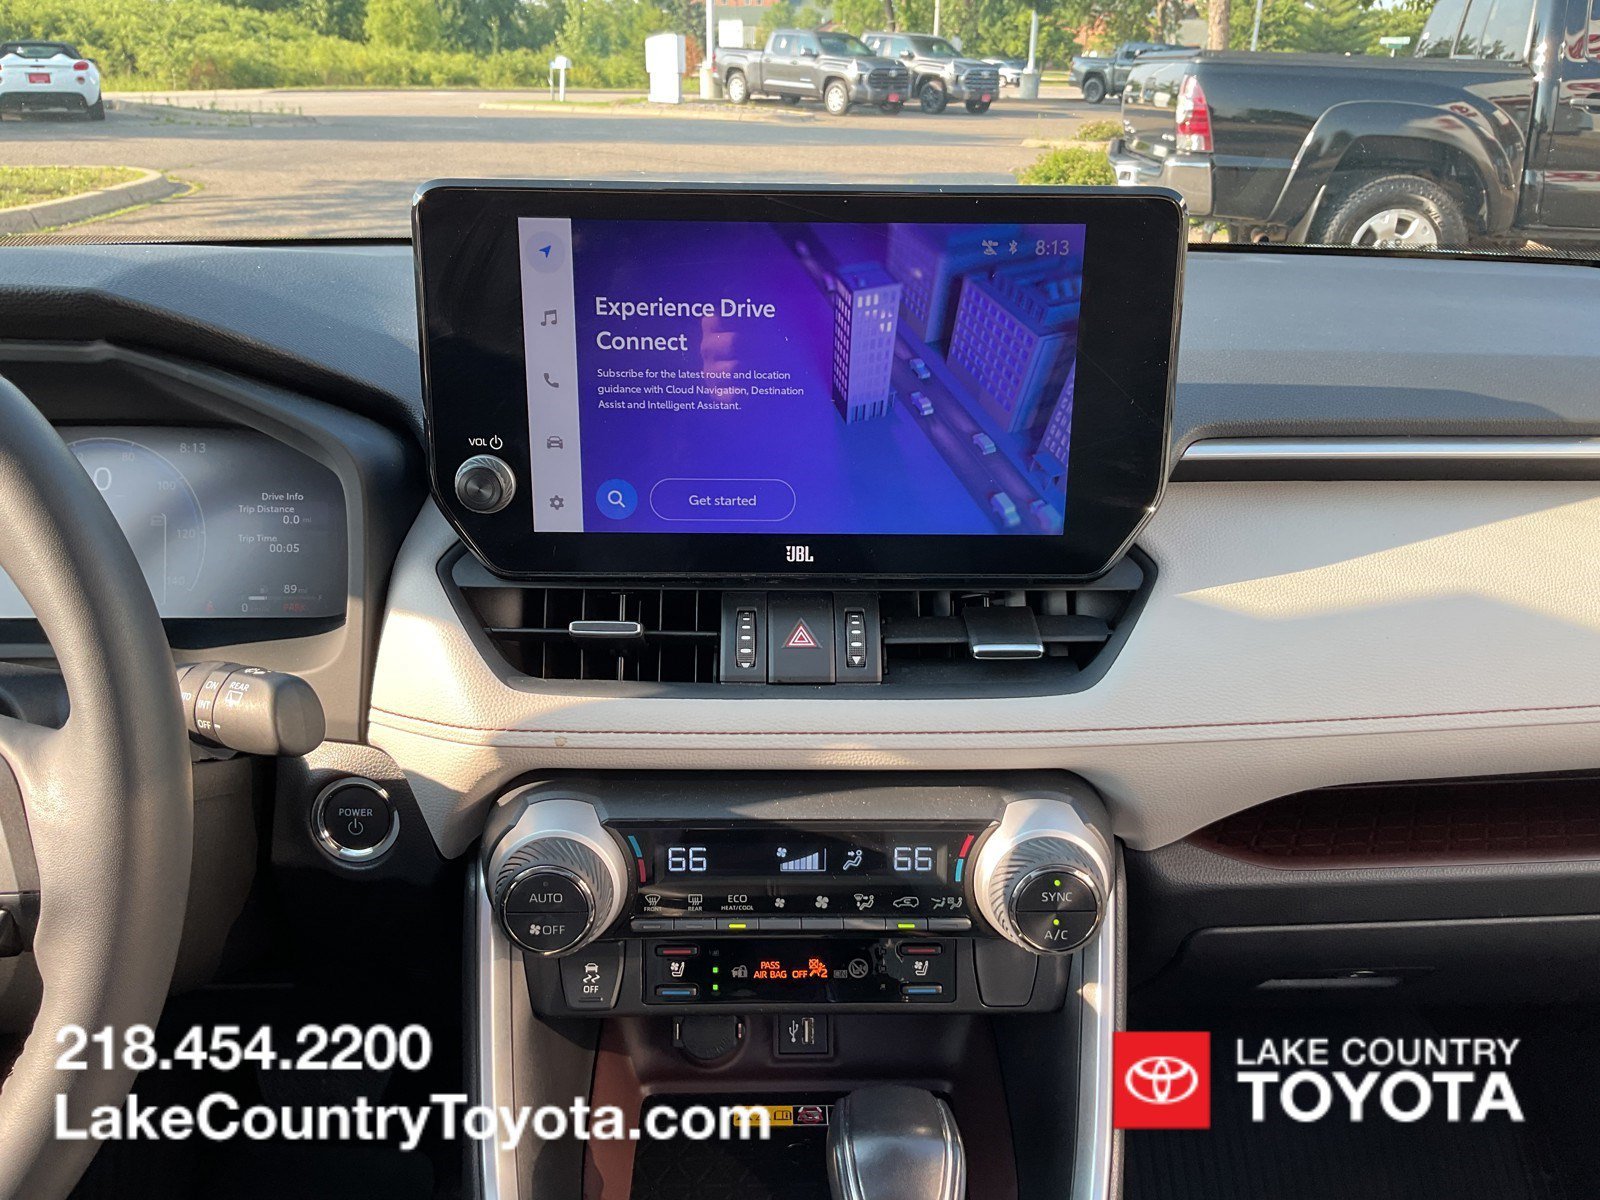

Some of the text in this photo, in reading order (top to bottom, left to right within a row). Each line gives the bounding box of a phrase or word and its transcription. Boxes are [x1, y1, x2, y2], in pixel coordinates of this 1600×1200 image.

[1035, 239, 1070, 256] 8:13
[595, 296, 776, 321] Experience Drive
[596, 331, 688, 351] Connect
[597, 368, 791, 380] Subscribe for the latest route and location
[597, 384, 804, 397] guidance with Cloud Navigation, Destination
[597, 399, 742, 412] Assist and Intelligent Assistant.
[468, 437, 488, 447] VOL
[179, 442, 207, 454] 8:13
[93, 466, 113, 491] 0
[261, 492, 304, 501] Drive Info
[688, 494, 757, 506] Get started
[238, 504, 295, 514] Trip Distance
[282, 515, 300, 525] 0.0
[238, 534, 278, 544] Trip Time
[269, 543, 300, 553] 00:05
[785, 545, 814, 562] JBL
[283, 584, 298, 594] 89
[205, 680, 219, 690] ON
[229, 681, 250, 692] REAR
[197, 719, 212, 729] OFF
[338, 808, 373, 817] POWER
[667, 846, 932, 872] 66 66
[529, 893, 563, 903] AUTO
[727, 894, 748, 903] ECO
[1041, 891, 1073, 902] SYNC
[542, 925, 566, 935] OFF
[1044, 929, 1068, 941] A/C
[760, 961, 781, 970] PASS
[753, 970, 808, 979] AIR BAG OFF
[583, 985, 599, 994] OFF
